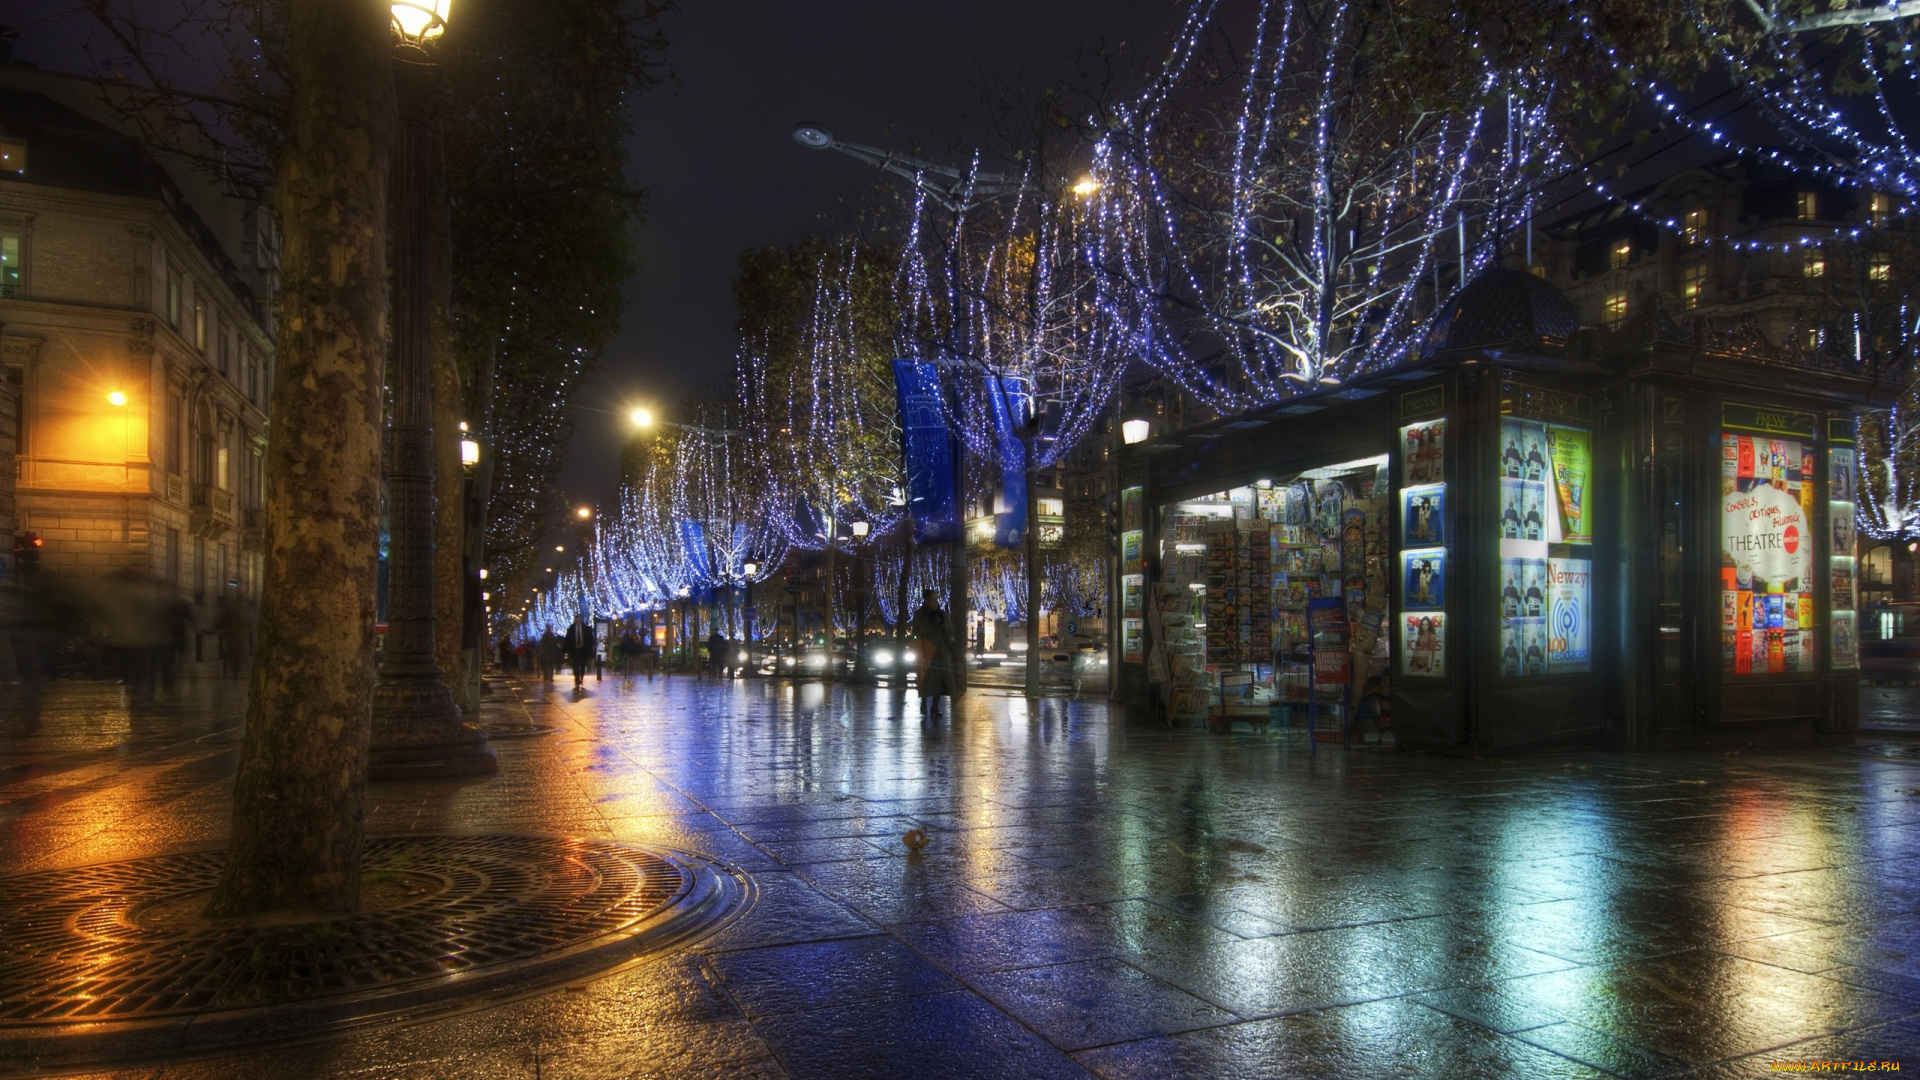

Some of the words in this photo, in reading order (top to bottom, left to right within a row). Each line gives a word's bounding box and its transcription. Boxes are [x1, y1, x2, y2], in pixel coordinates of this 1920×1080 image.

[1406, 394, 1439, 411] PRESSE
[1755, 412, 1787, 430] PRESSE
[911, 432, 946, 444] CHAMPS
[1407, 423, 1443, 440] Stff
[911, 454, 949, 469] 2008
[1411, 496, 1441, 507] Stff
[1728, 533, 1783, 552] THEATRE
[1411, 558, 1441, 570] Stff
[1546, 564, 1588, 588] Newzy
[1407, 615, 1443, 629] Stff
[1548, 637, 1567, 652] 100
